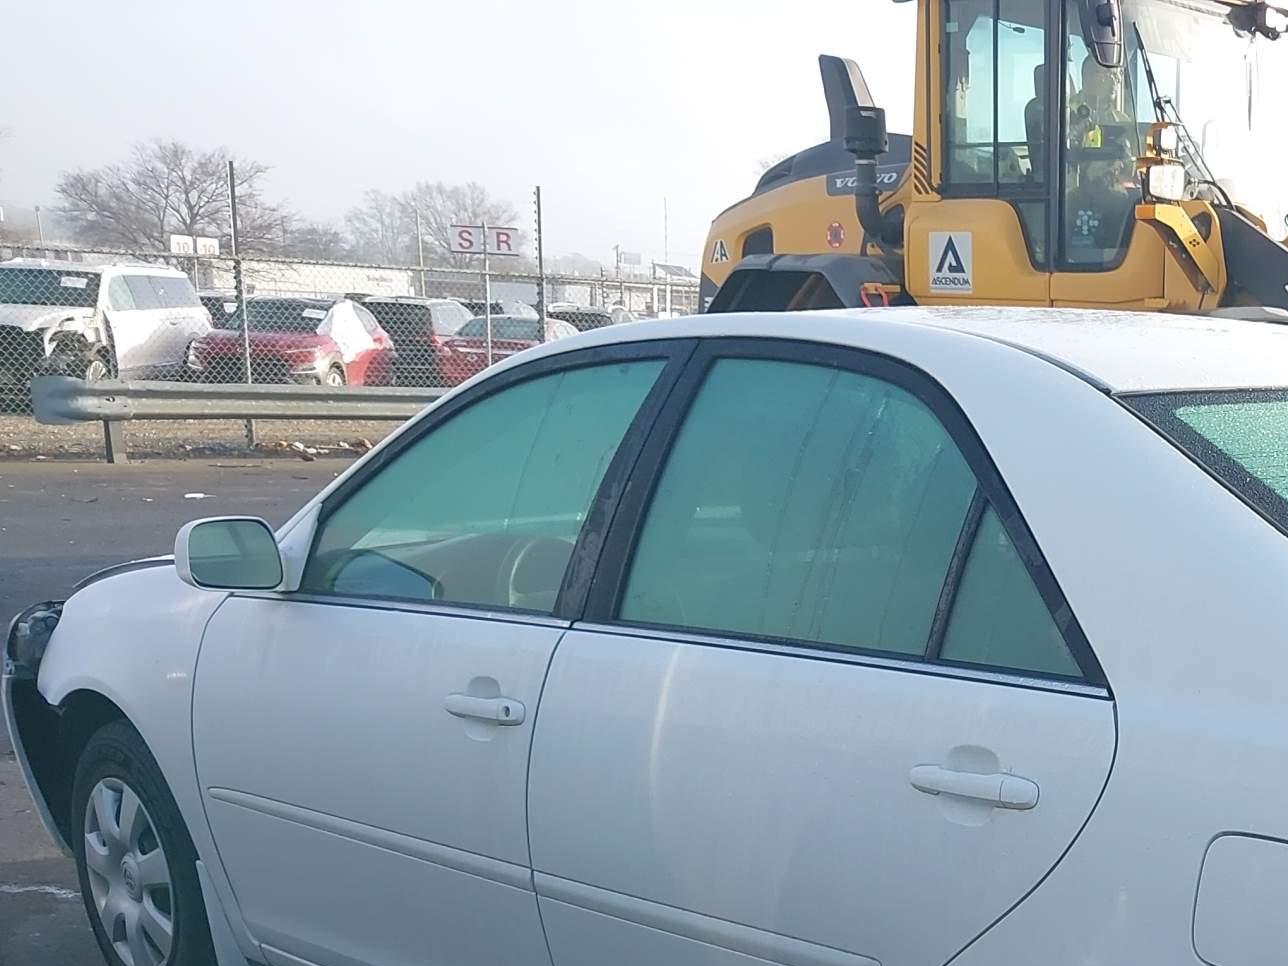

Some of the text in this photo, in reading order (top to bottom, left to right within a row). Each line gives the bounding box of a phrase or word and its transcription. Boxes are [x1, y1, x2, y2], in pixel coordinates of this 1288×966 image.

[834, 172, 898, 188] VOVO
[457, 229, 513, 252] S R
